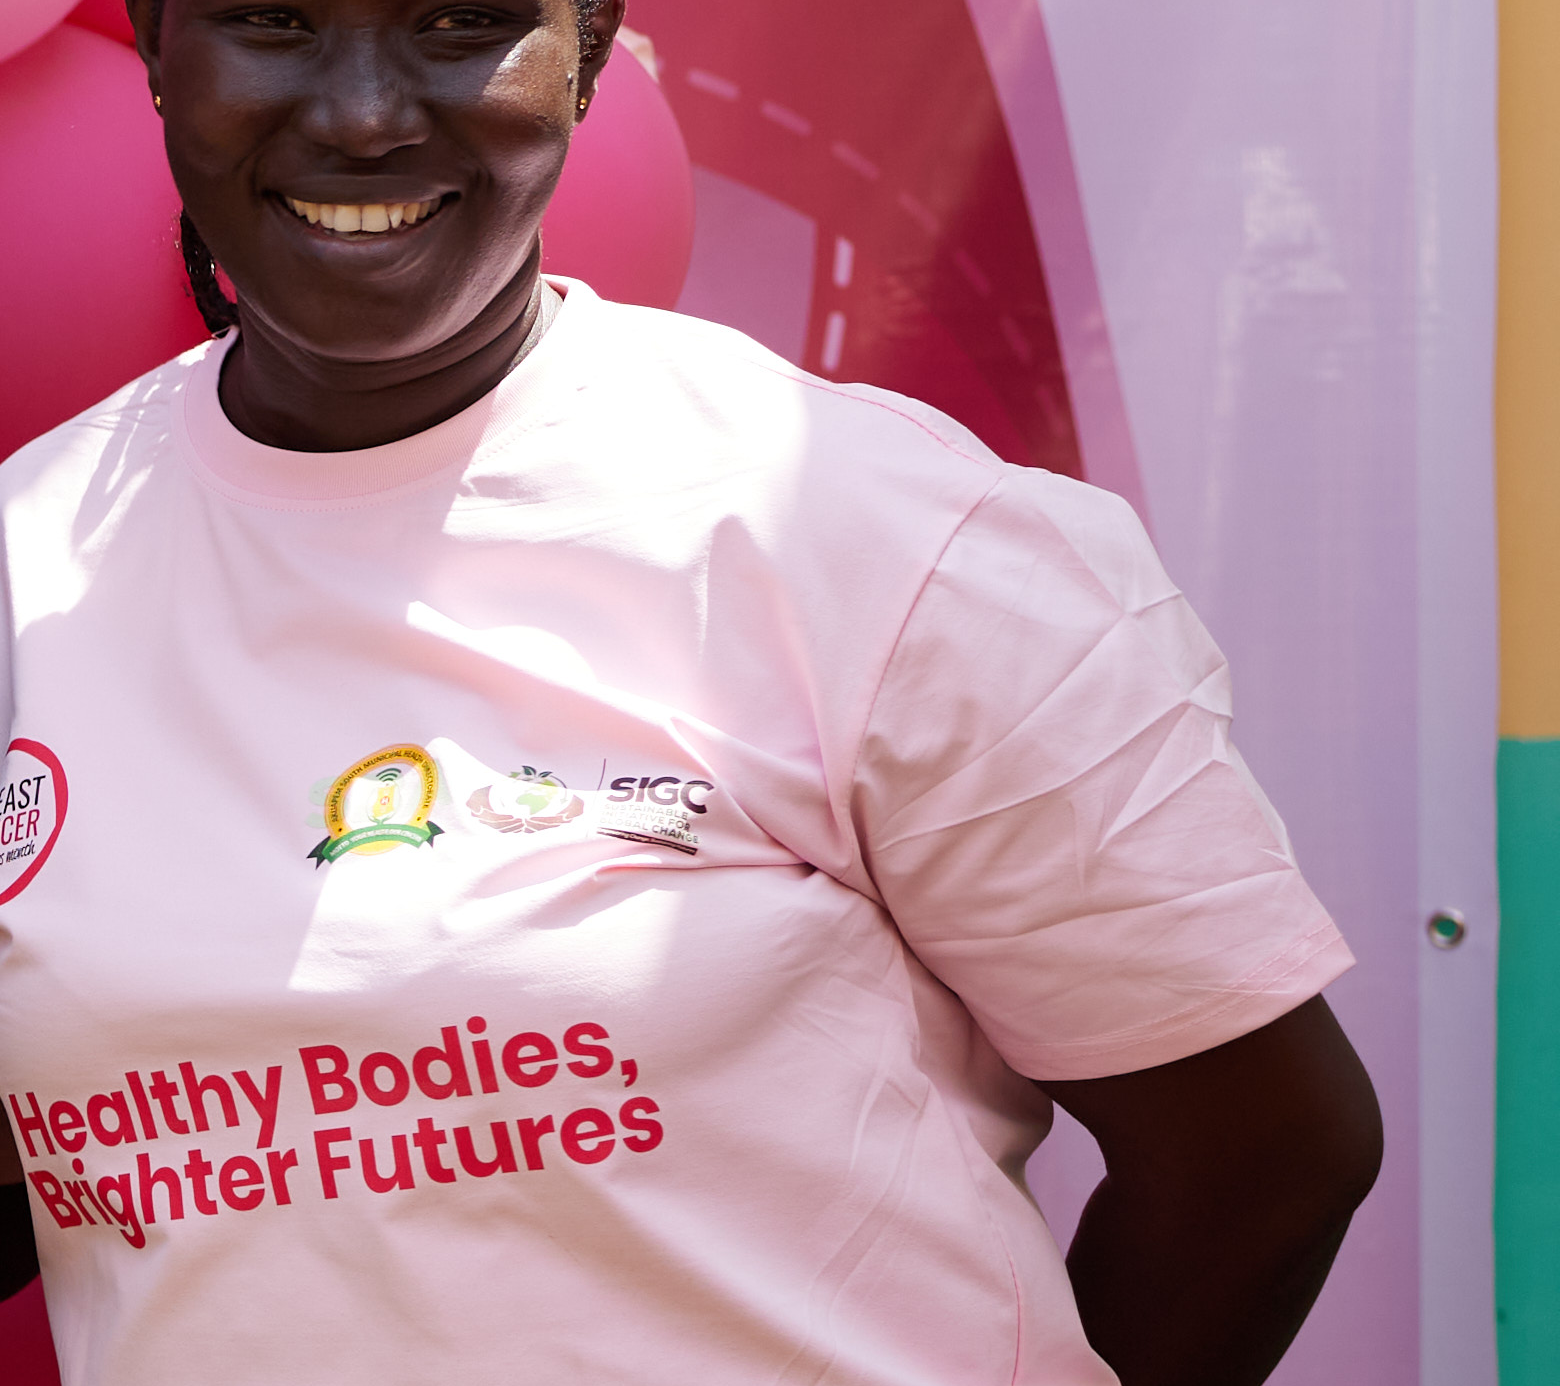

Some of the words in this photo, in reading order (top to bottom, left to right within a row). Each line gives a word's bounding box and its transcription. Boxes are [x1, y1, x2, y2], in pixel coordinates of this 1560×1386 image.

[607, 777, 714, 814] SIGC
[651, 825, 699, 844] CHANGE
[668, 818, 691, 832] FOR
[9, 1061, 282, 1157] Healthy
[299, 1016, 638, 1115] Bodies,
[28, 1148, 298, 1249] Brighter
[314, 1096, 663, 1199] Futures
